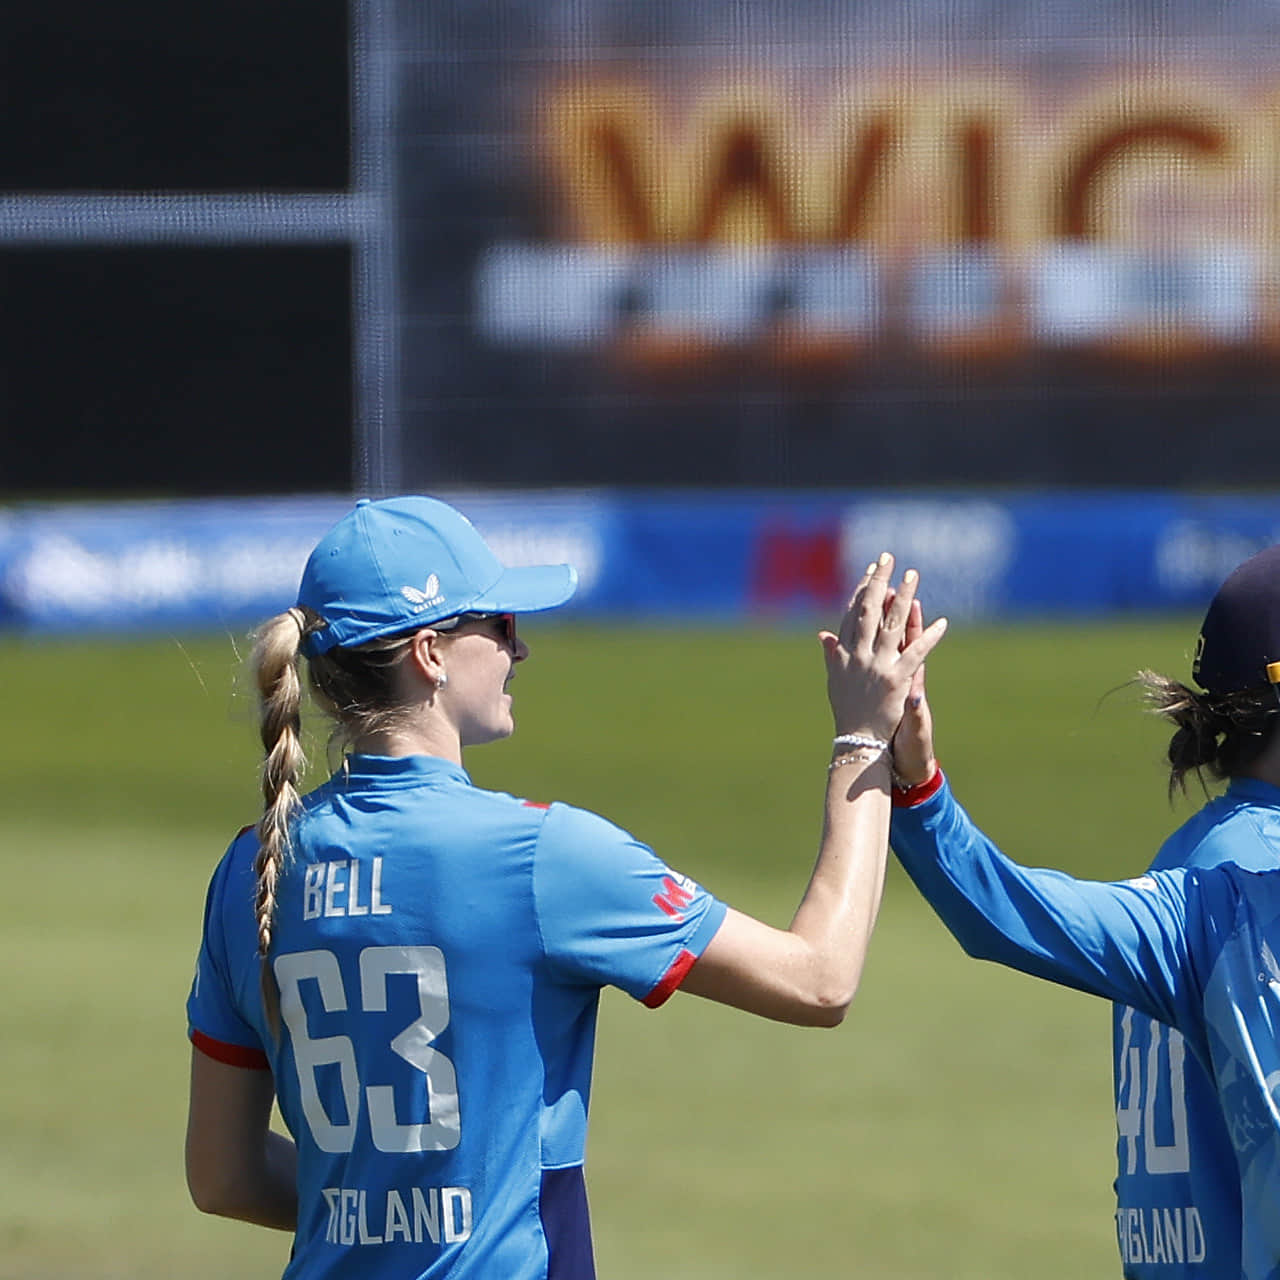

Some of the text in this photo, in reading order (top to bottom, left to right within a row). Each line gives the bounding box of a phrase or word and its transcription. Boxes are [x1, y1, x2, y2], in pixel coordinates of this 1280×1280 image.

[303, 856, 393, 921] BELL
[273, 945, 462, 1153] 63
[1117, 1004, 1190, 1175] 40
